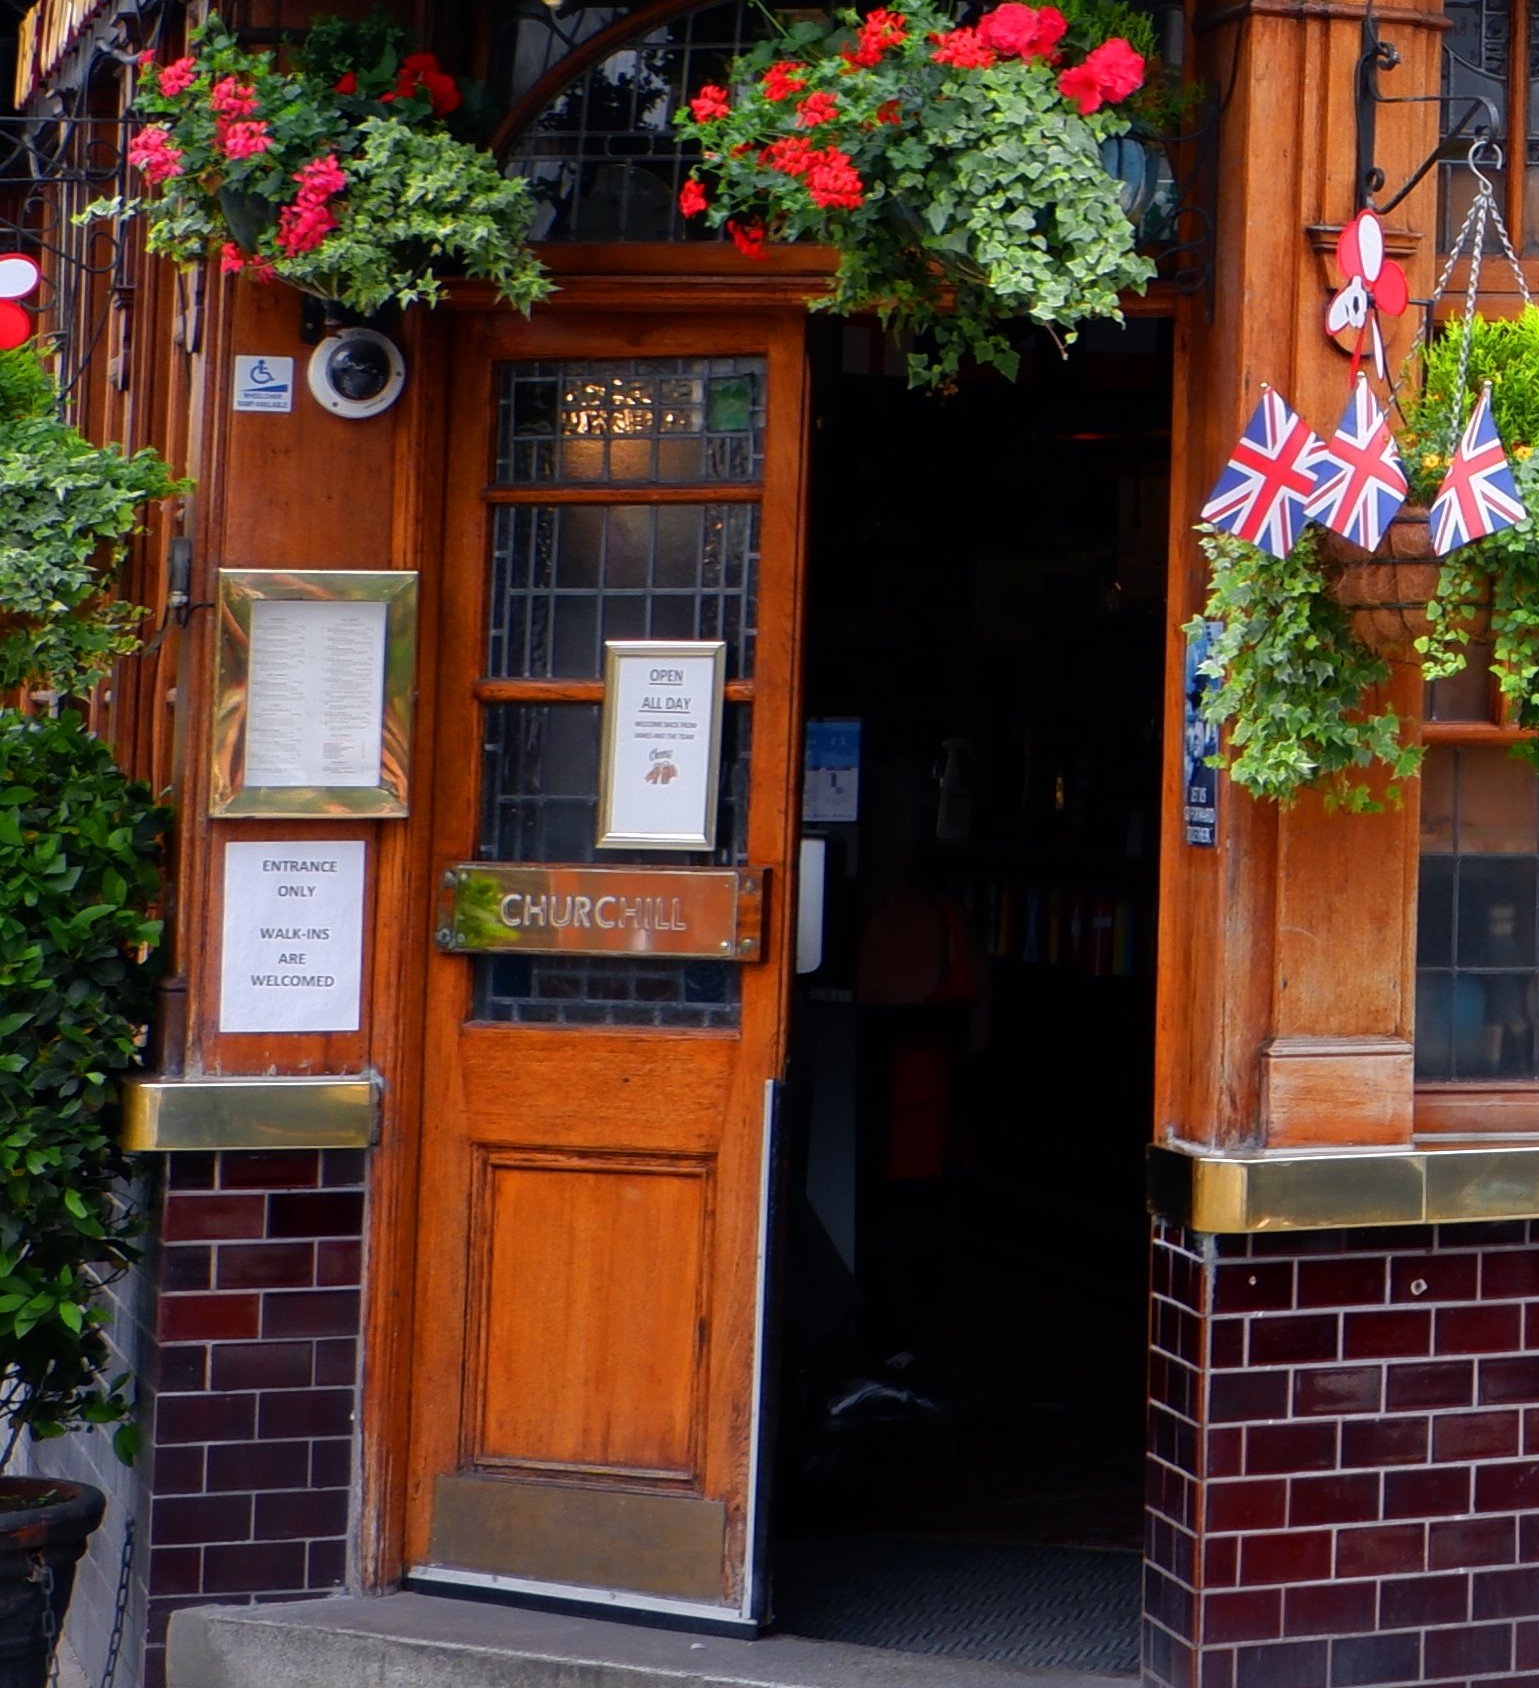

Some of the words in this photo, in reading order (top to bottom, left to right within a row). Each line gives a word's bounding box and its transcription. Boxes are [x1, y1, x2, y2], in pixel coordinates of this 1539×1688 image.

[649, 669, 684, 682] OPEN
[641, 697, 662, 710] ALL
[666, 697, 692, 710] DAY
[262, 860, 337, 872] ENTRANCE
[277, 885, 316, 897] ONLY
[500, 893, 687, 931] CHURCHILL
[260, 928, 330, 940] WALK-INS
[278, 953, 306, 964] ARE
[250, 975, 335, 987] WELCOMED
